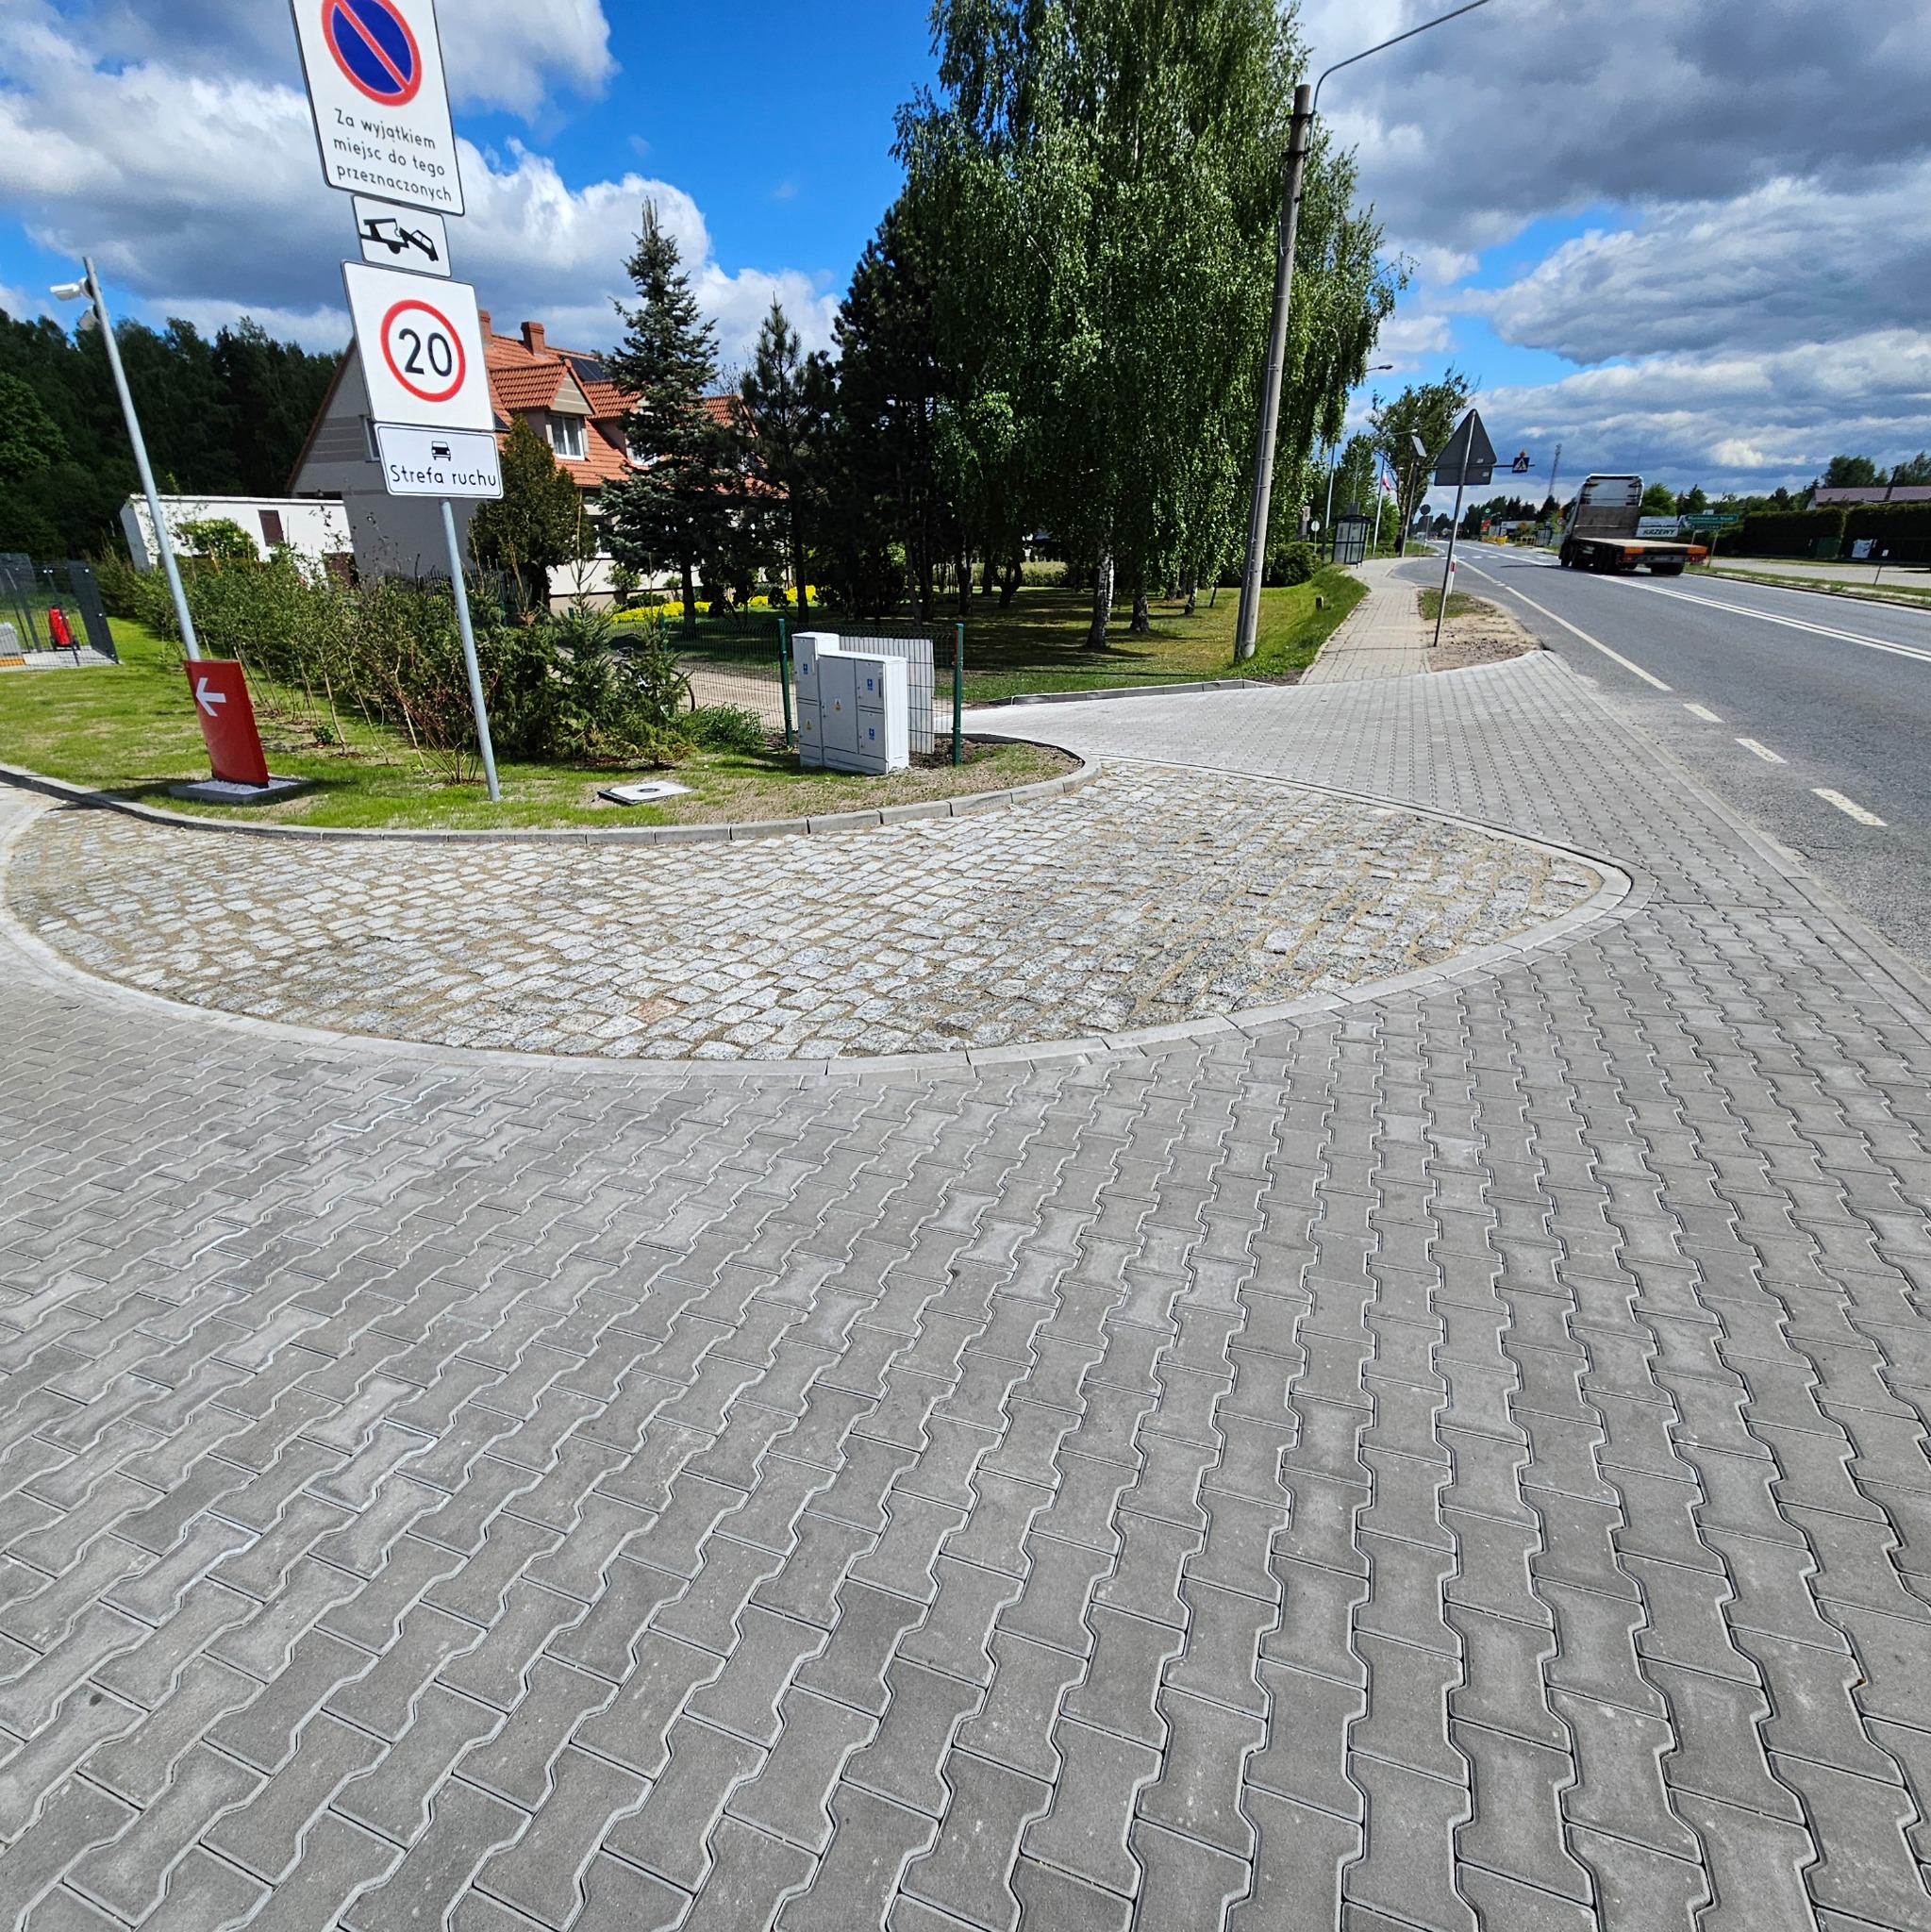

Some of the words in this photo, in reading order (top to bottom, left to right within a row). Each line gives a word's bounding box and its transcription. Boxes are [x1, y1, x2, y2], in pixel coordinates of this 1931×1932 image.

[335, 108, 355, 127] Za
[360, 120, 436, 150] wyjątkiem
[333, 138, 382, 160] miejsc
[389, 149, 407, 166] do
[412, 156, 445, 177] tego
[337, 165, 452, 202] przeznaczonych
[398, 328, 453, 377] 20
[390, 464, 444, 484] Strefa
[452, 469, 496, 487] ruchu
